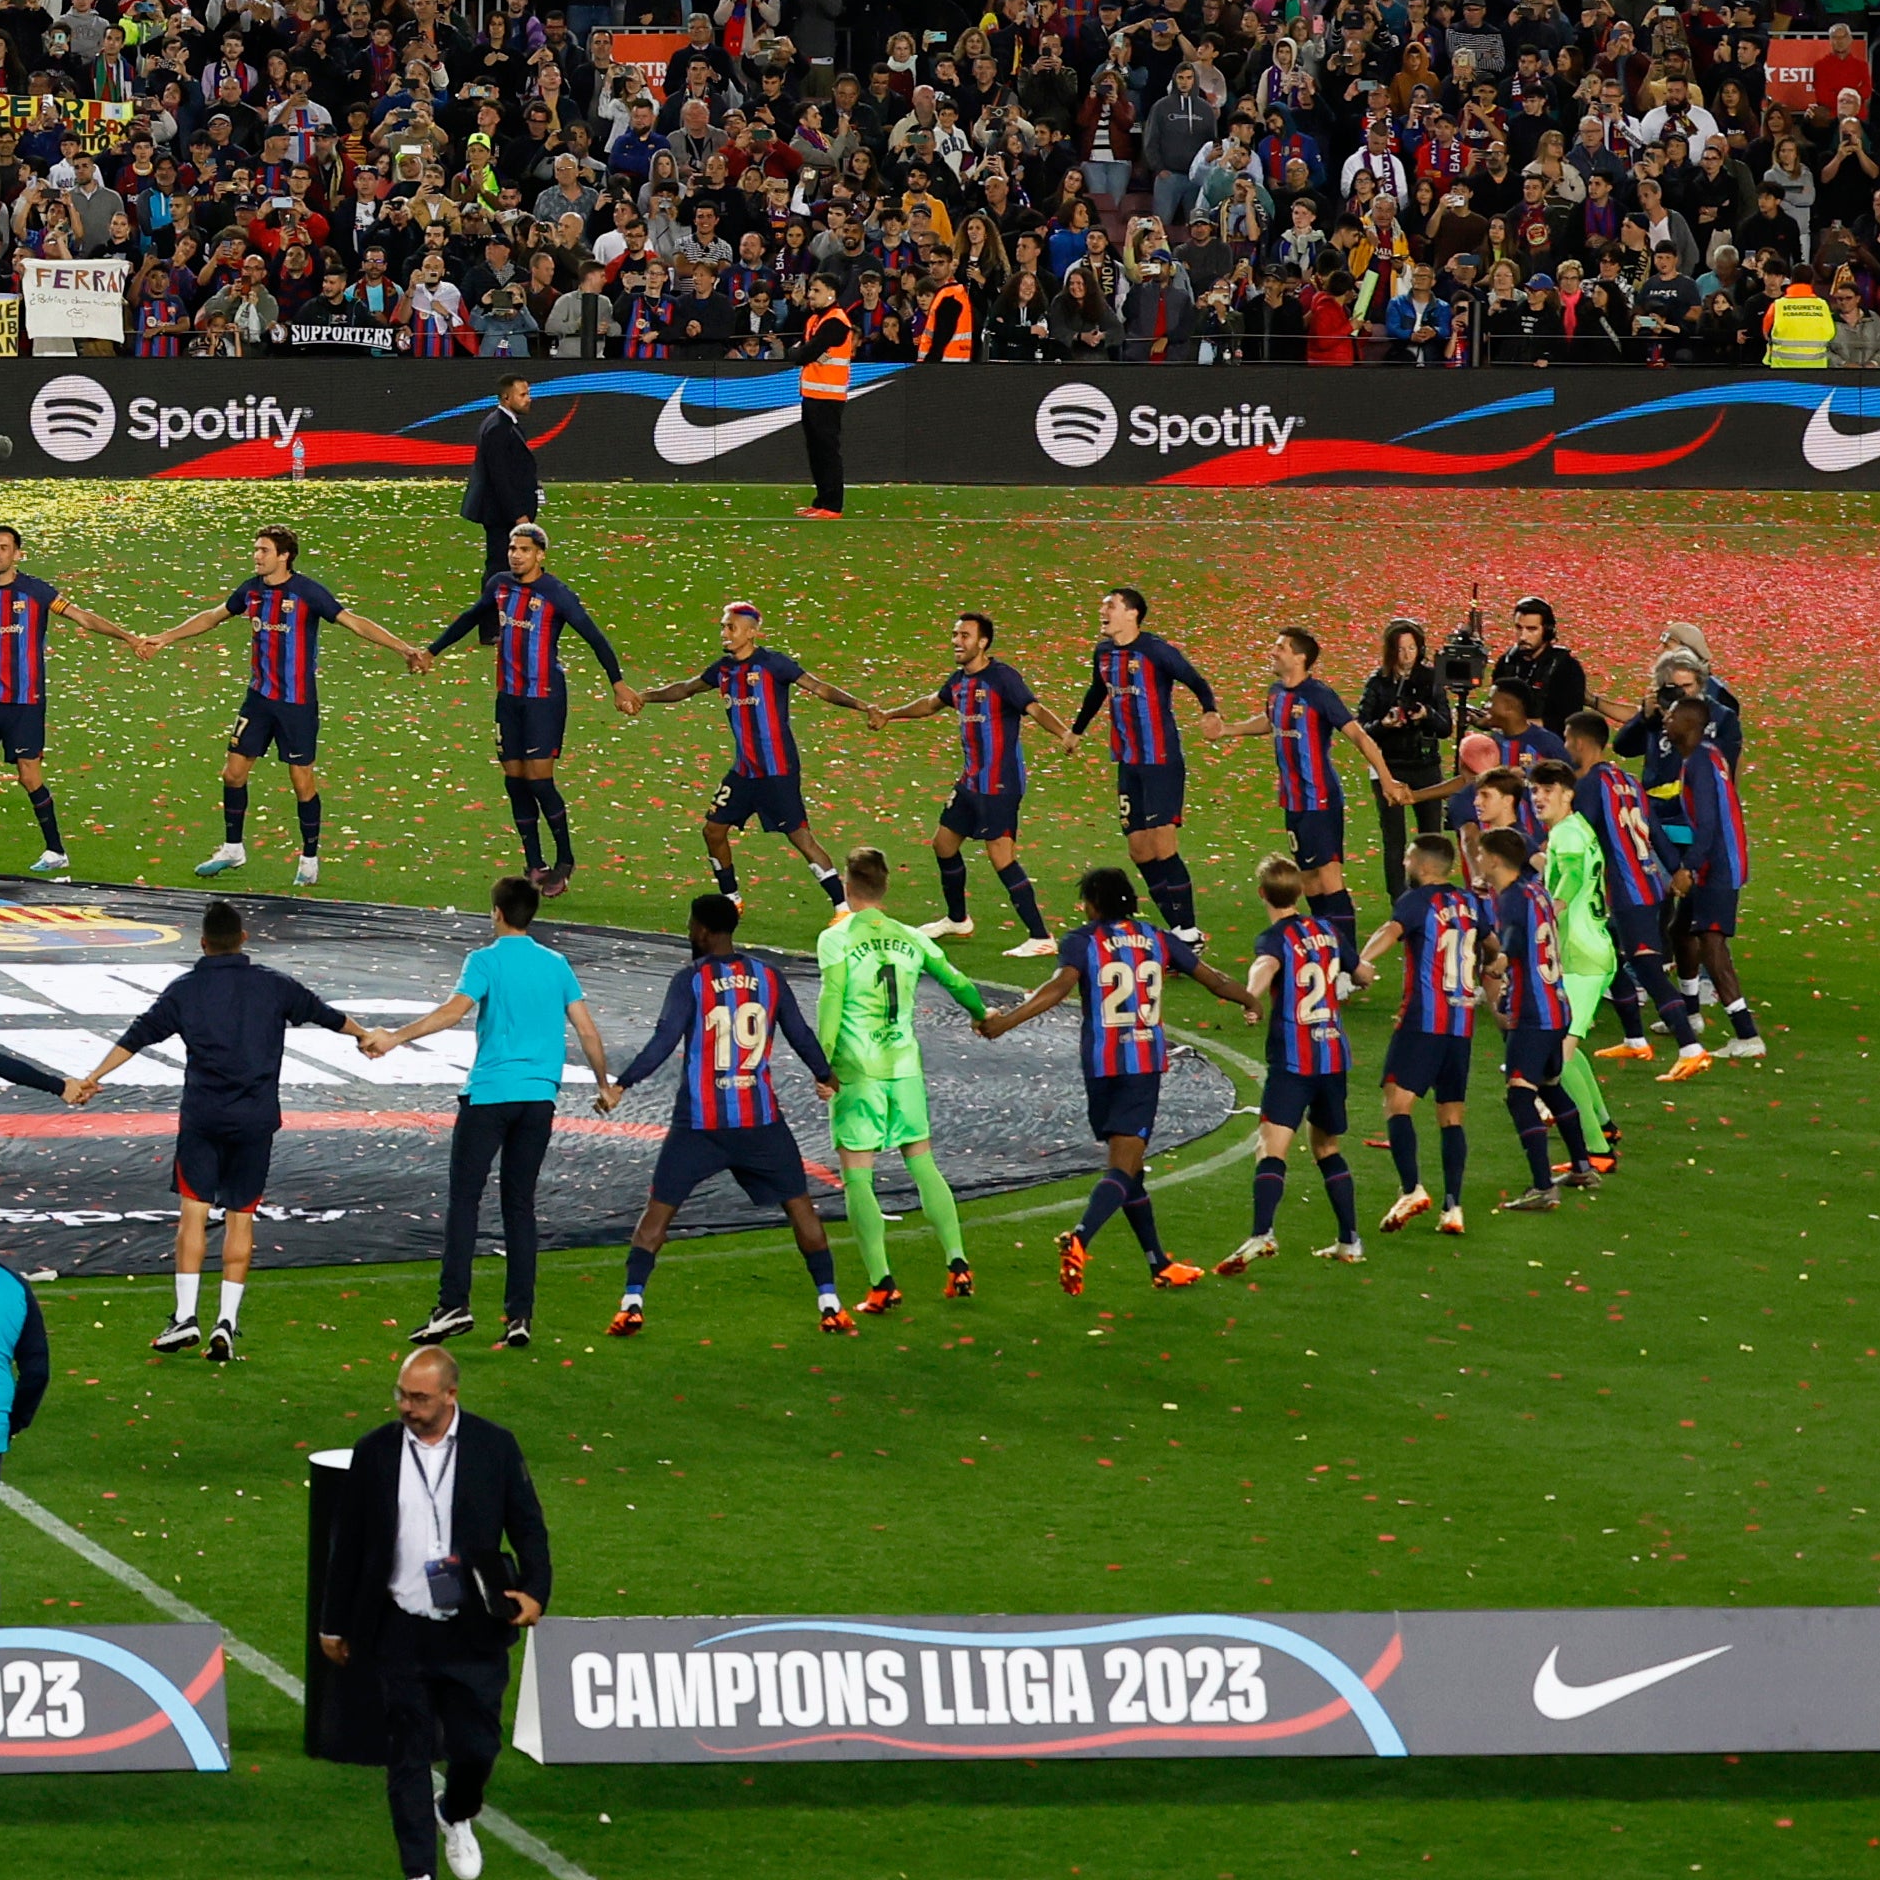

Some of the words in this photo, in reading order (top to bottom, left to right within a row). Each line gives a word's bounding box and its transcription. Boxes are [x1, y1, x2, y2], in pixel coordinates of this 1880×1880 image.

[35, 268, 129, 293] FERRAN
[291, 324, 395, 348] SUPPORTERS
[127, 394, 303, 449] Spotify
[1129, 403, 1297, 456] Spotify
[262, 622, 291, 634] Spotify
[507, 618, 536, 631] Spotify
[873, 937, 916, 959] STEGEN
[1102, 937, 1156, 955] KOUNDE
[710, 976, 760, 994] KESSIE
[876, 964, 899, 1025] 1
[1099, 959, 1164, 1028] 23
[706, 1003, 770, 1075] 19
[570, 1647, 908, 1729] CAMPIONS
[919, 1647, 1096, 1725] LLIGA
[1105, 1645, 1267, 1724] 2023
